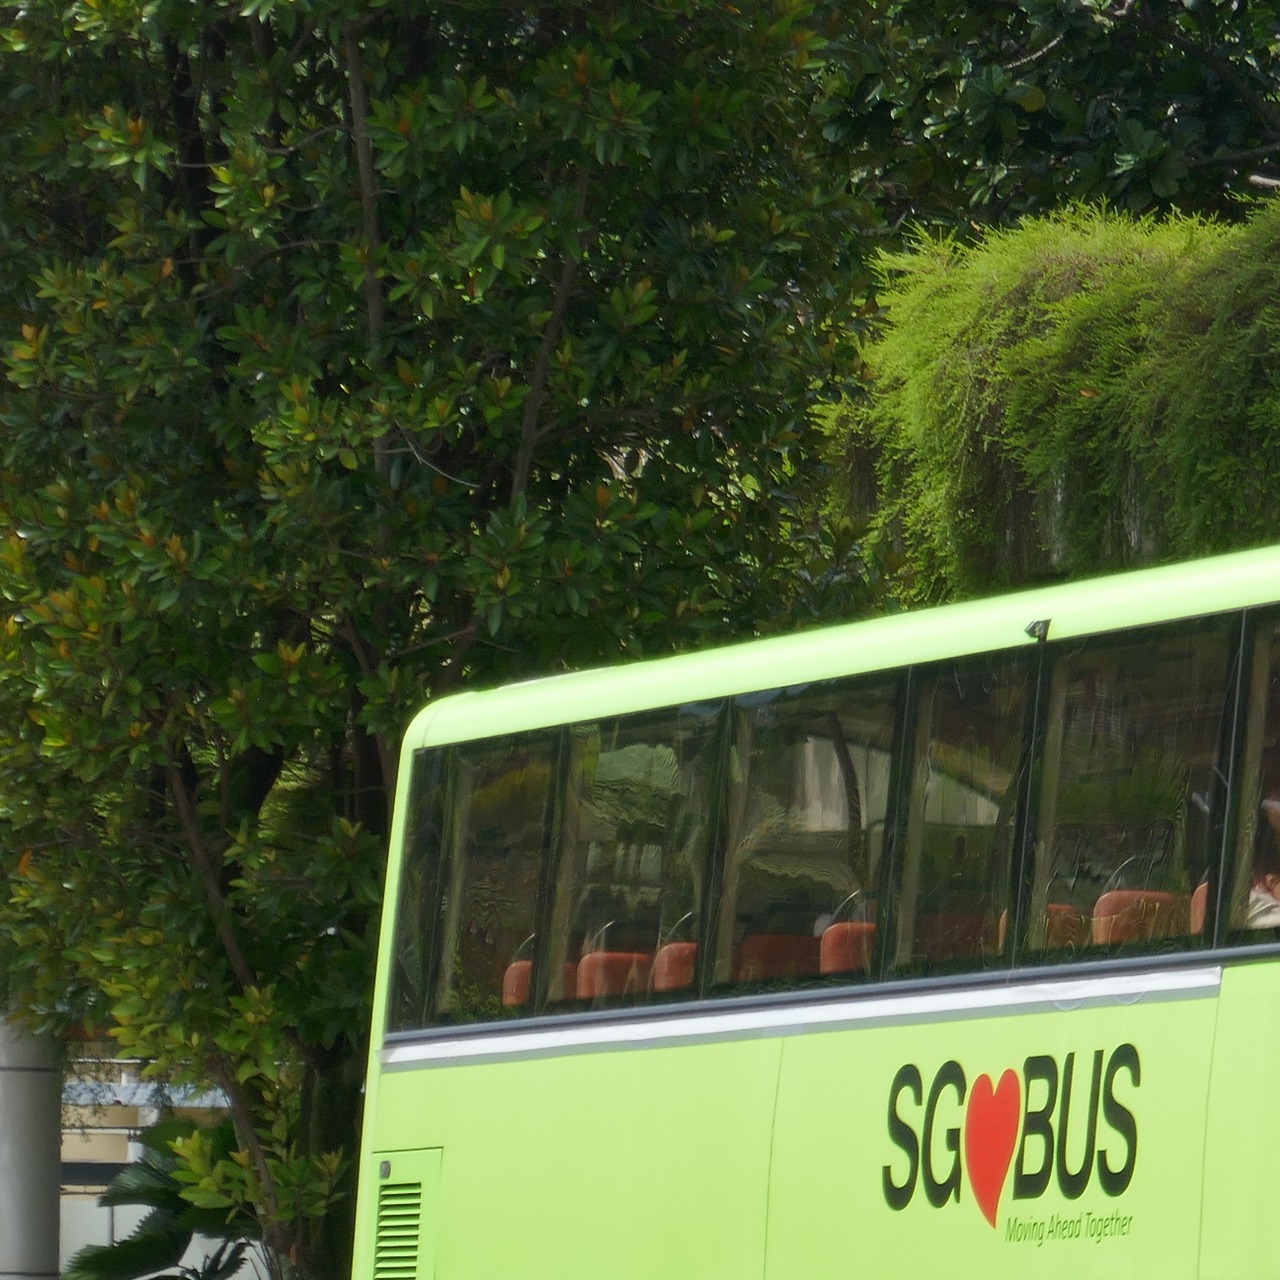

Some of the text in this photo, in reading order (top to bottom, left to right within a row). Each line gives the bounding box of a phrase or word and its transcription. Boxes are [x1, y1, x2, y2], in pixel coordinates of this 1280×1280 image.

[1012, 1043, 1141, 1200] BUS
[1005, 1208, 1134, 1248] Moving Ahead Together
